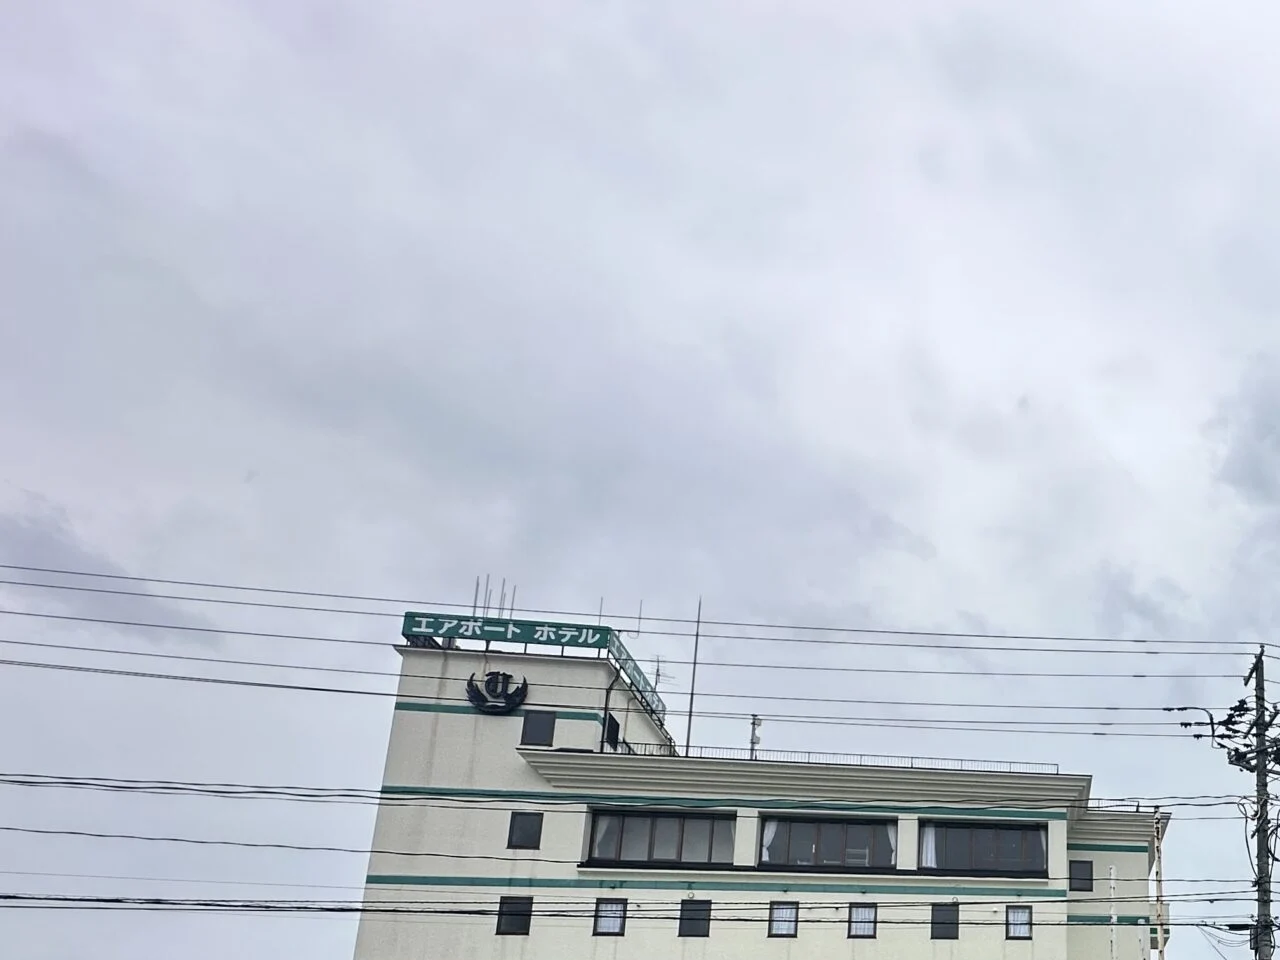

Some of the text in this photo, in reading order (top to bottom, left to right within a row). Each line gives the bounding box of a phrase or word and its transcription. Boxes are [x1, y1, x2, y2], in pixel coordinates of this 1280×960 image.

[412, 616, 601, 644] エアポート ホテル
